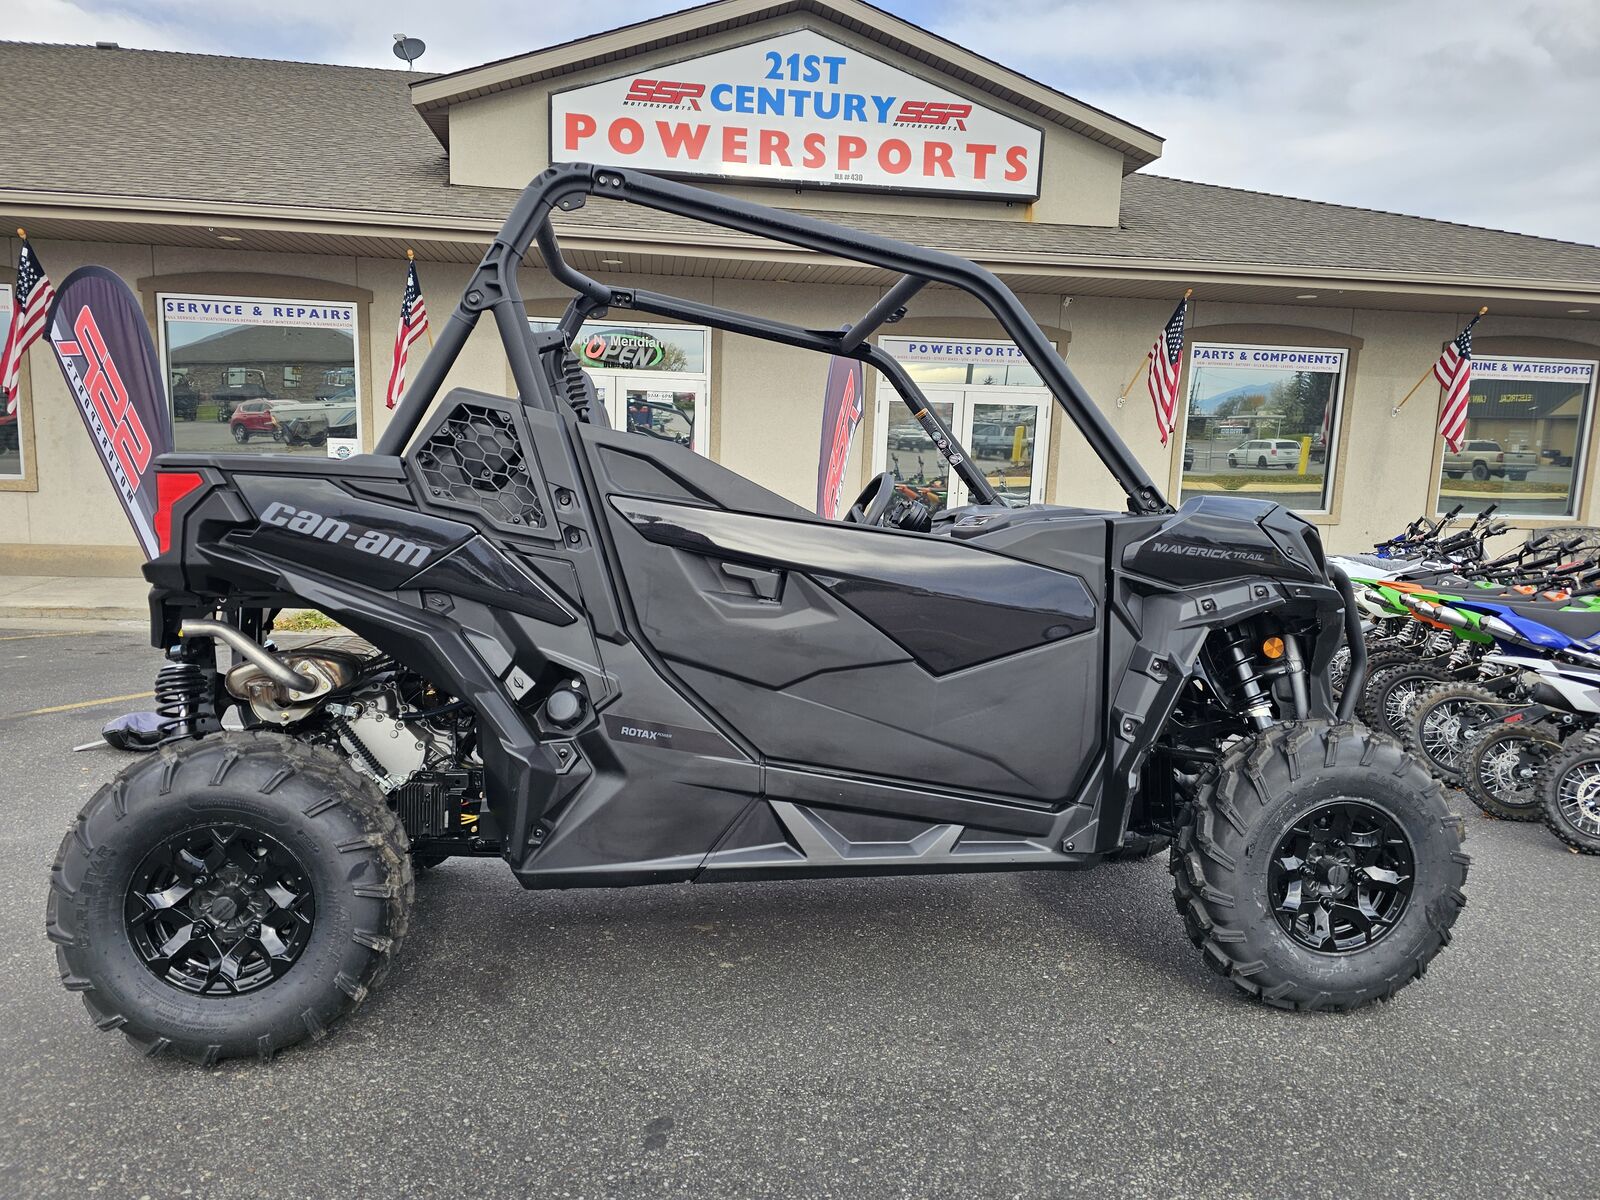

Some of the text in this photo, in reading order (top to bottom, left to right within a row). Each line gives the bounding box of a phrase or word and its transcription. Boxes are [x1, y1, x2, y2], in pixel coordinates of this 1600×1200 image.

[764, 51, 846, 85] 21ST
[625, 79, 706, 112] SSR
[710, 84, 897, 125] CENTURY
[622, 100, 692, 111] MOTORSPORTS
[895, 101, 973, 132] SSR
[892, 122, 958, 132] MOTORSPORTS
[565, 112, 1028, 183] POWERSPORTS
[166, 302, 351, 320] SERVICE & REPAIRS
[610, 335, 664, 348] Meridian
[909, 343, 1023, 357] POWERSPORTS
[585, 337, 654, 368] OPEN
[1193, 350, 1338, 364] PARTS & COMPONENTS
[1471, 362, 1591, 375] RINE & WATERSPORTS
[1152, 542, 1265, 561] MAVERICK TRAIL
[621, 726, 657, 740] ROTAX
